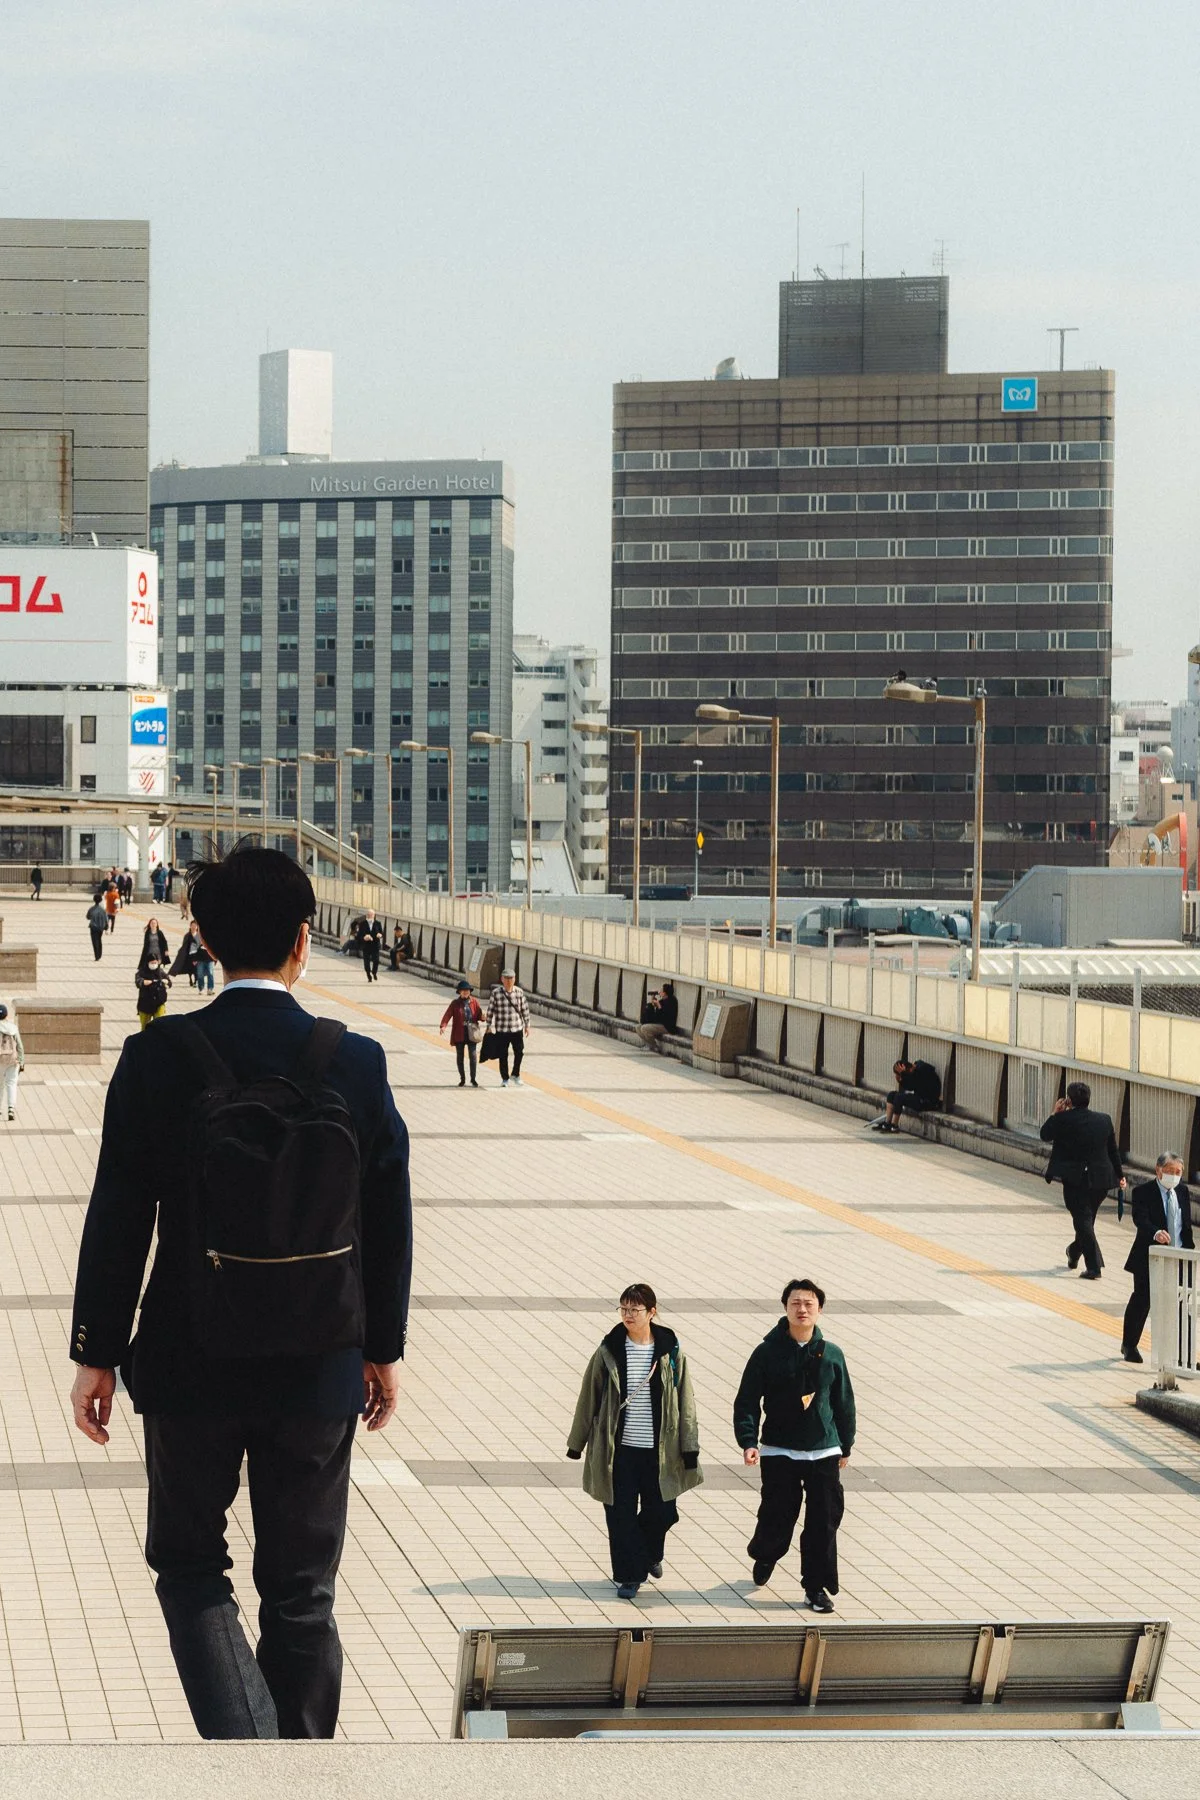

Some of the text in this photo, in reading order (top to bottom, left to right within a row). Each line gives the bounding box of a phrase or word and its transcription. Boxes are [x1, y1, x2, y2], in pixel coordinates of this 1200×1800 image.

[310, 472, 495, 492] Mitsui Garden Hotel
[131, 601, 154, 625] アコム
[134, 719, 165, 732] セントラル
